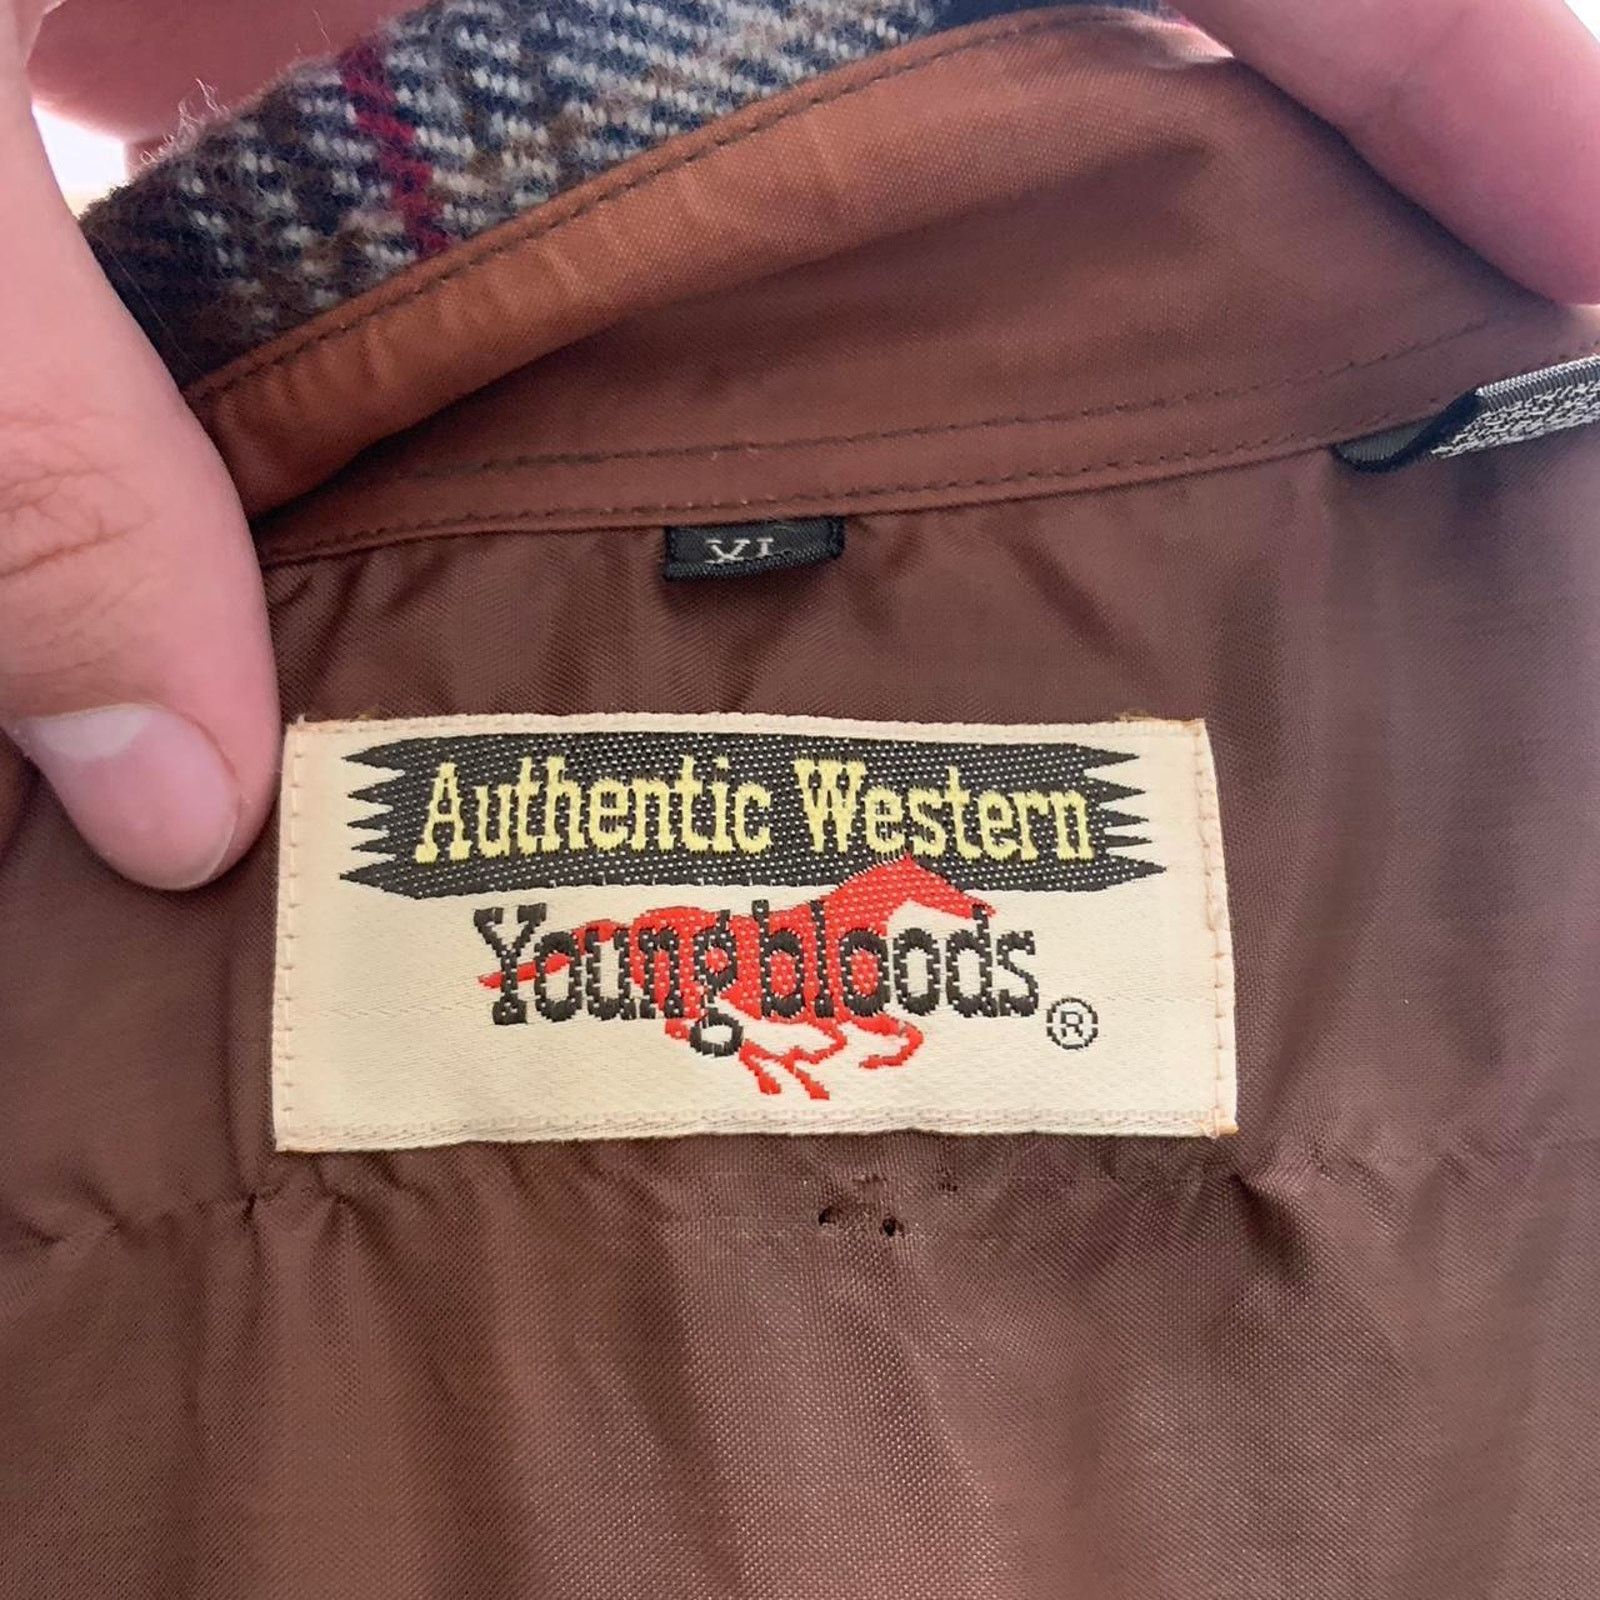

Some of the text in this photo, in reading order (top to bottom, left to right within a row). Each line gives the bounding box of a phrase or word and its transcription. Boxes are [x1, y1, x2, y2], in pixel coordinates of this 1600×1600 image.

[414, 755, 1094, 864] Authentic Western
[474, 899, 1039, 1056] Youngbloods
